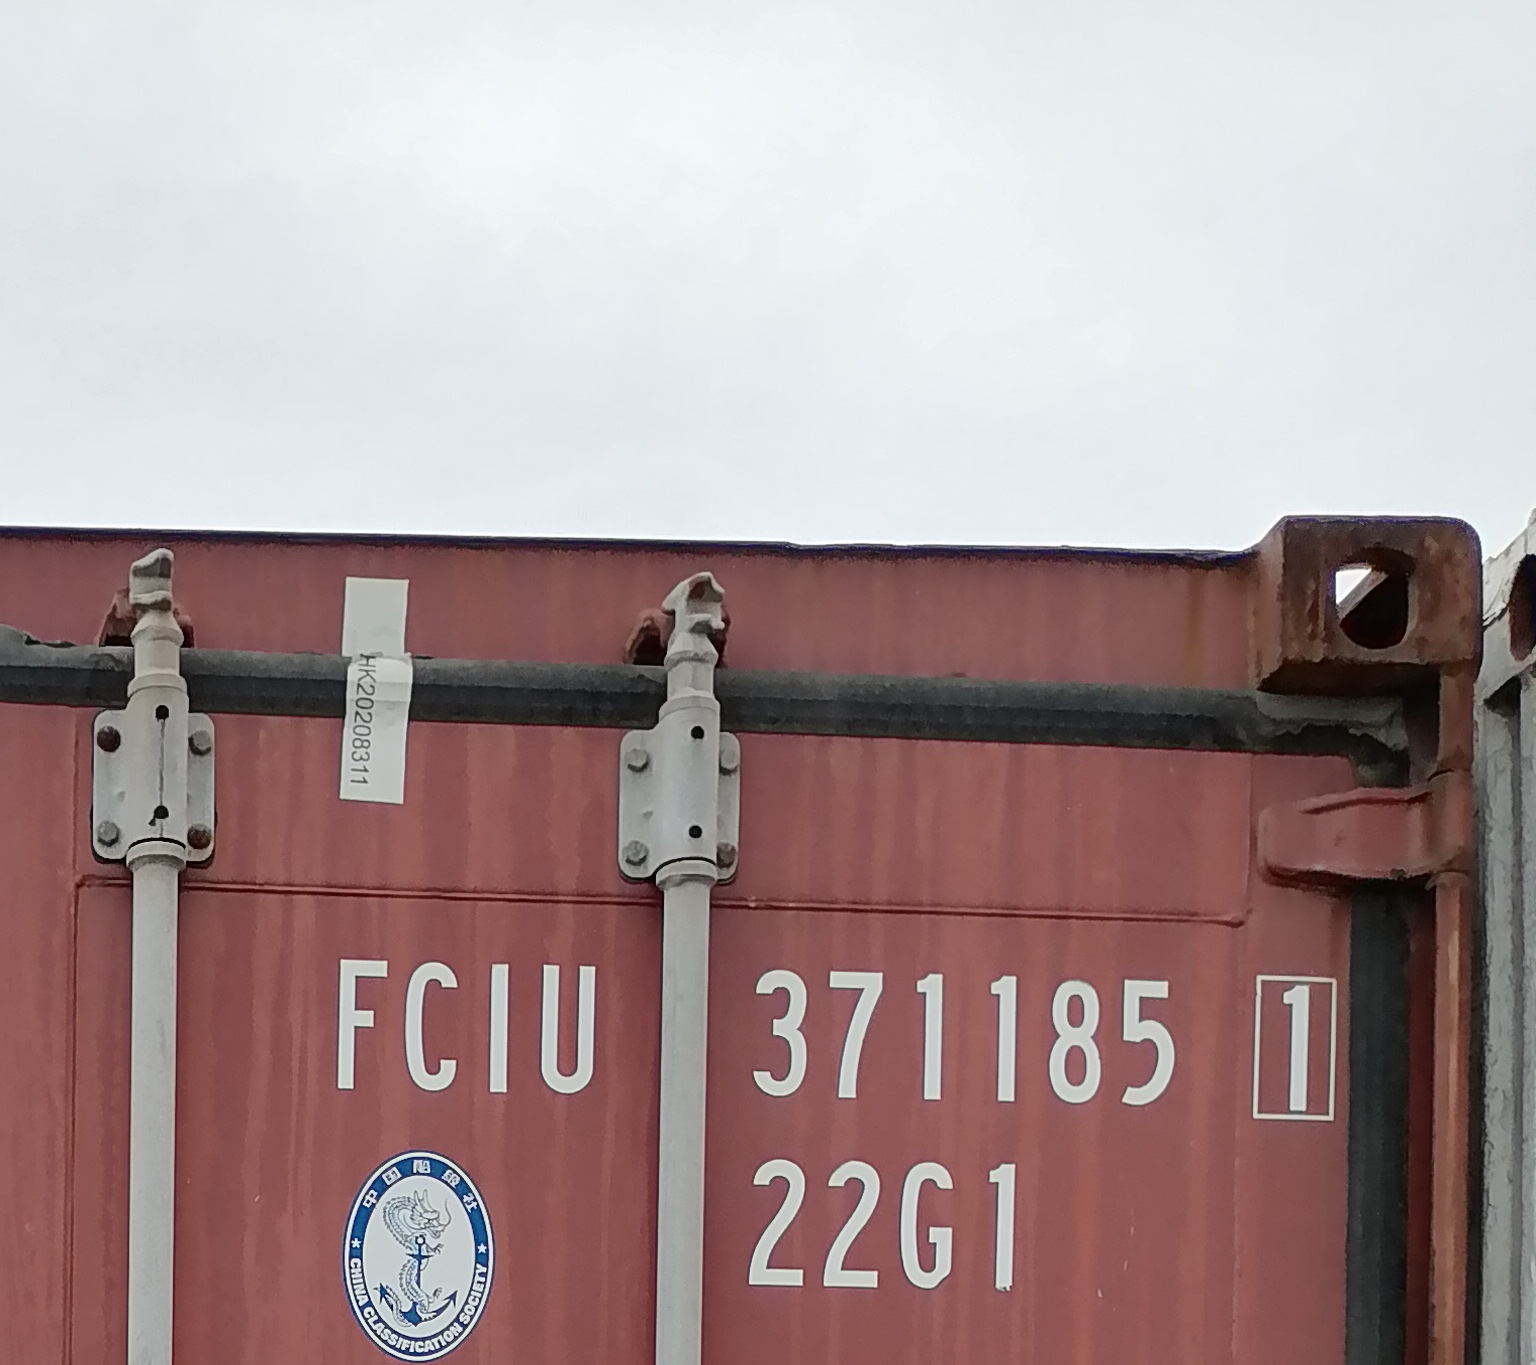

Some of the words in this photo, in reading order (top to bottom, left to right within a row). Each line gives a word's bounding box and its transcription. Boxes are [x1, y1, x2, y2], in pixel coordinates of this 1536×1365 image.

[337, 958, 596, 1094] FCIU
[753, 969, 1176, 1106] 371185
[1280, 984, 1311, 1113] 1
[748, 1158, 1016, 1292] 22G1
[349, 1257, 369, 1305] CHINA
[362, 1307, 464, 1354] CLASSIFICATION
[458, 1263, 488, 1325] SOCIETY
